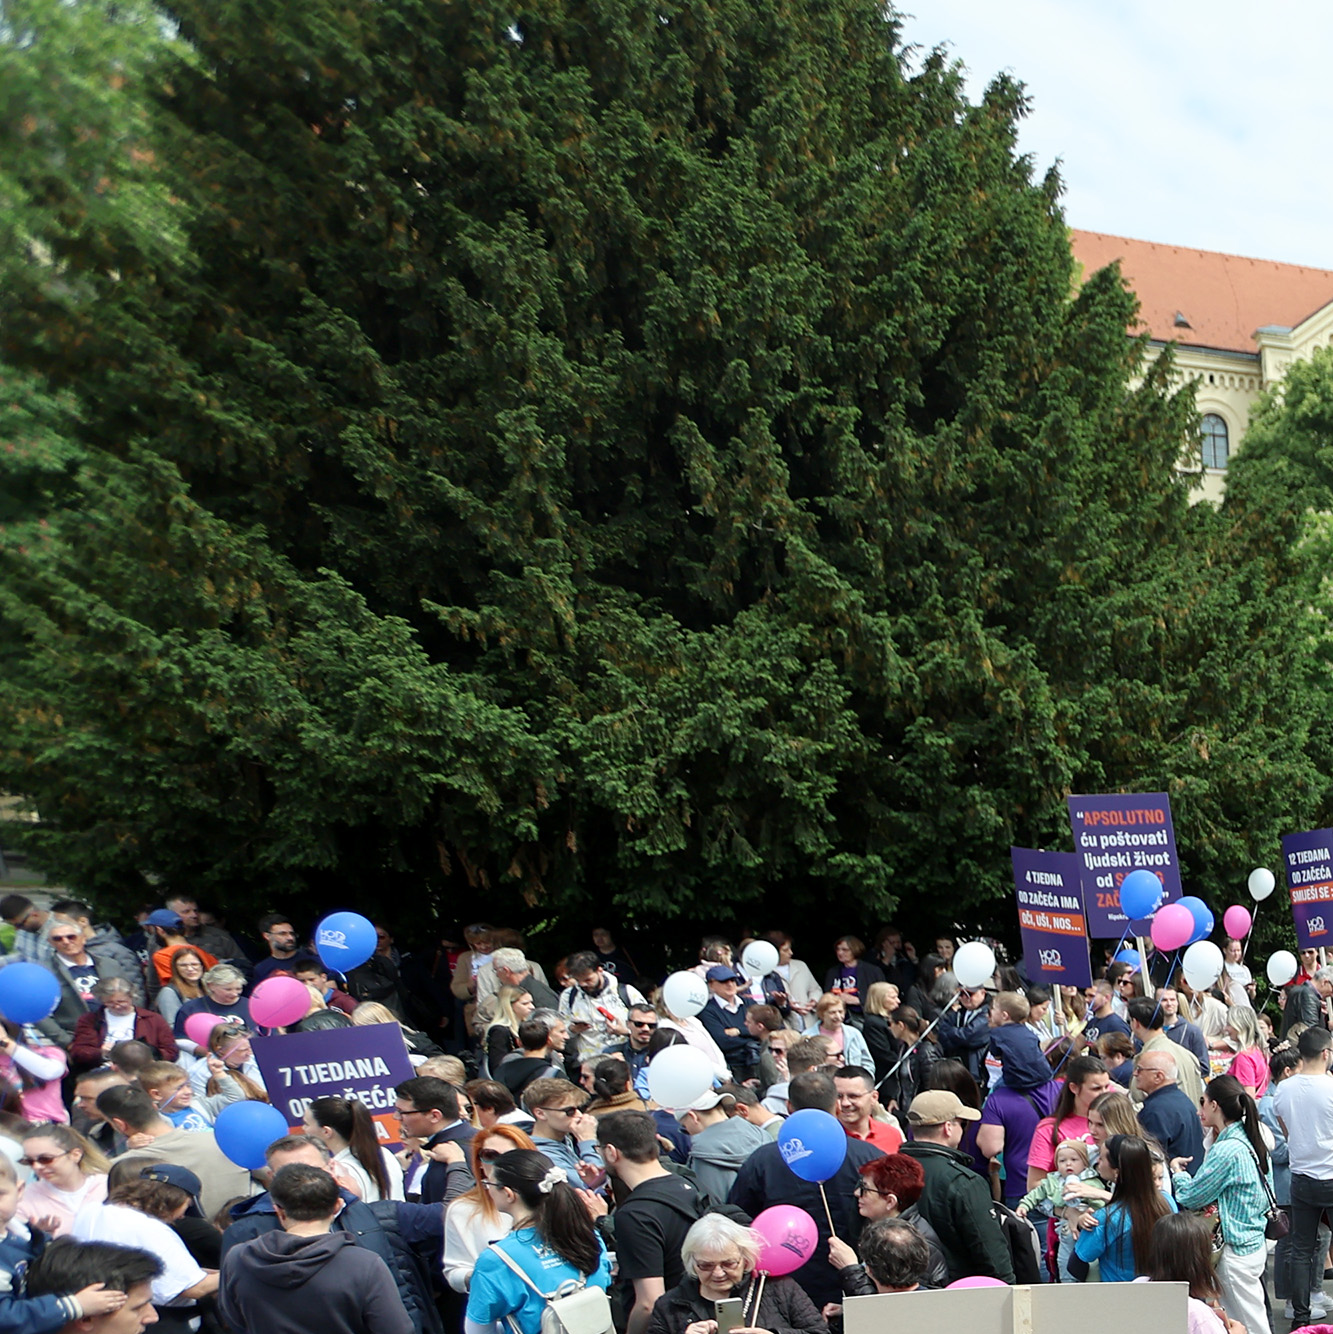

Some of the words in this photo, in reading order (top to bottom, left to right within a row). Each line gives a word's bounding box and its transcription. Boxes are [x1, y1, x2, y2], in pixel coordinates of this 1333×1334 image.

[1080, 831, 1098, 848] ću
[1100, 829, 1168, 850] poštovati
[1084, 851, 1131, 871] ljudski
[1134, 851, 1171, 867] život
[1288, 853, 1297, 866] 12
[1296, 847, 1331, 865] TJEDANA
[1025, 870, 1032, 883] 4
[1031, 871, 1064, 887] TJEDNA
[1096, 873, 1114, 888] od
[1291, 870, 1301, 884] OD
[1301, 864, 1332, 883] ZAČEĆA
[1018, 889, 1029, 903] OD
[1029, 889, 1060, 909] ZAČEĆA
[1060, 896, 1081, 910] IMA
[1292, 885, 1319, 903] SMIJEŠI
[1319, 886, 1330, 899] SE
[1021, 910, 1035, 928] OČI,
[1036, 913, 1052, 930] UŠI,
[1053, 917, 1082, 932] NOS...
[278, 1067, 293, 1087] 7
[294, 1056, 391, 1086] TJEDANA
